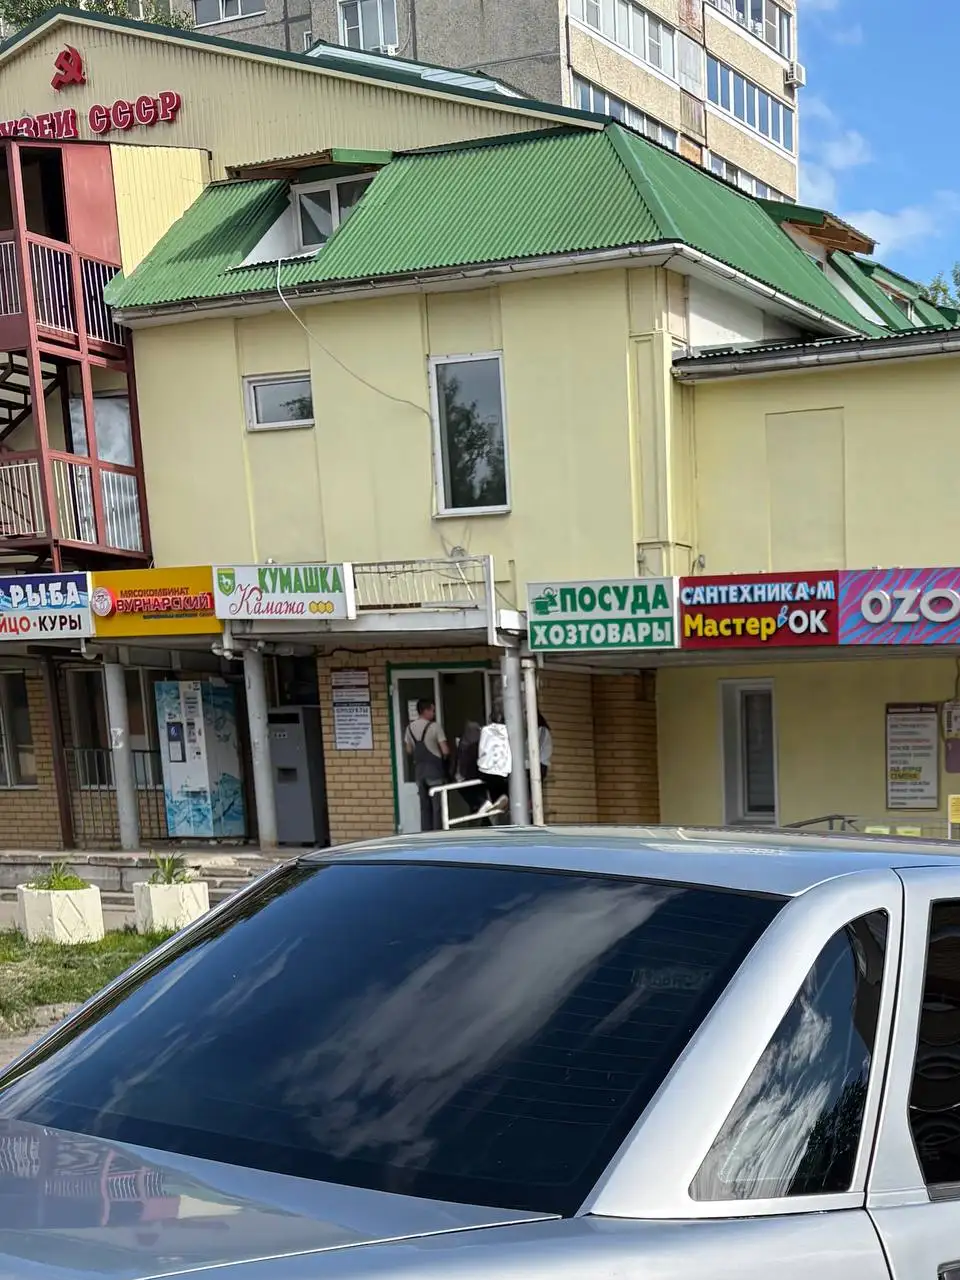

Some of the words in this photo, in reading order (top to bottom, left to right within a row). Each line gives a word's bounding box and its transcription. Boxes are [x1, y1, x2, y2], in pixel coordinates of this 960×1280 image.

[88, 90, 181, 134] СССР
[120, 587, 189, 598] МЯСОКОМБИНАТ
[257, 566, 343, 594] КУМАШКА
[9, 582, 81, 608] РЫБА
[116, 592, 212, 613] ВУРНАРСКИЙ
[559, 584, 669, 615] ПОСУДА
[533, 621, 672, 646] ХОЗТОВАРЫ
